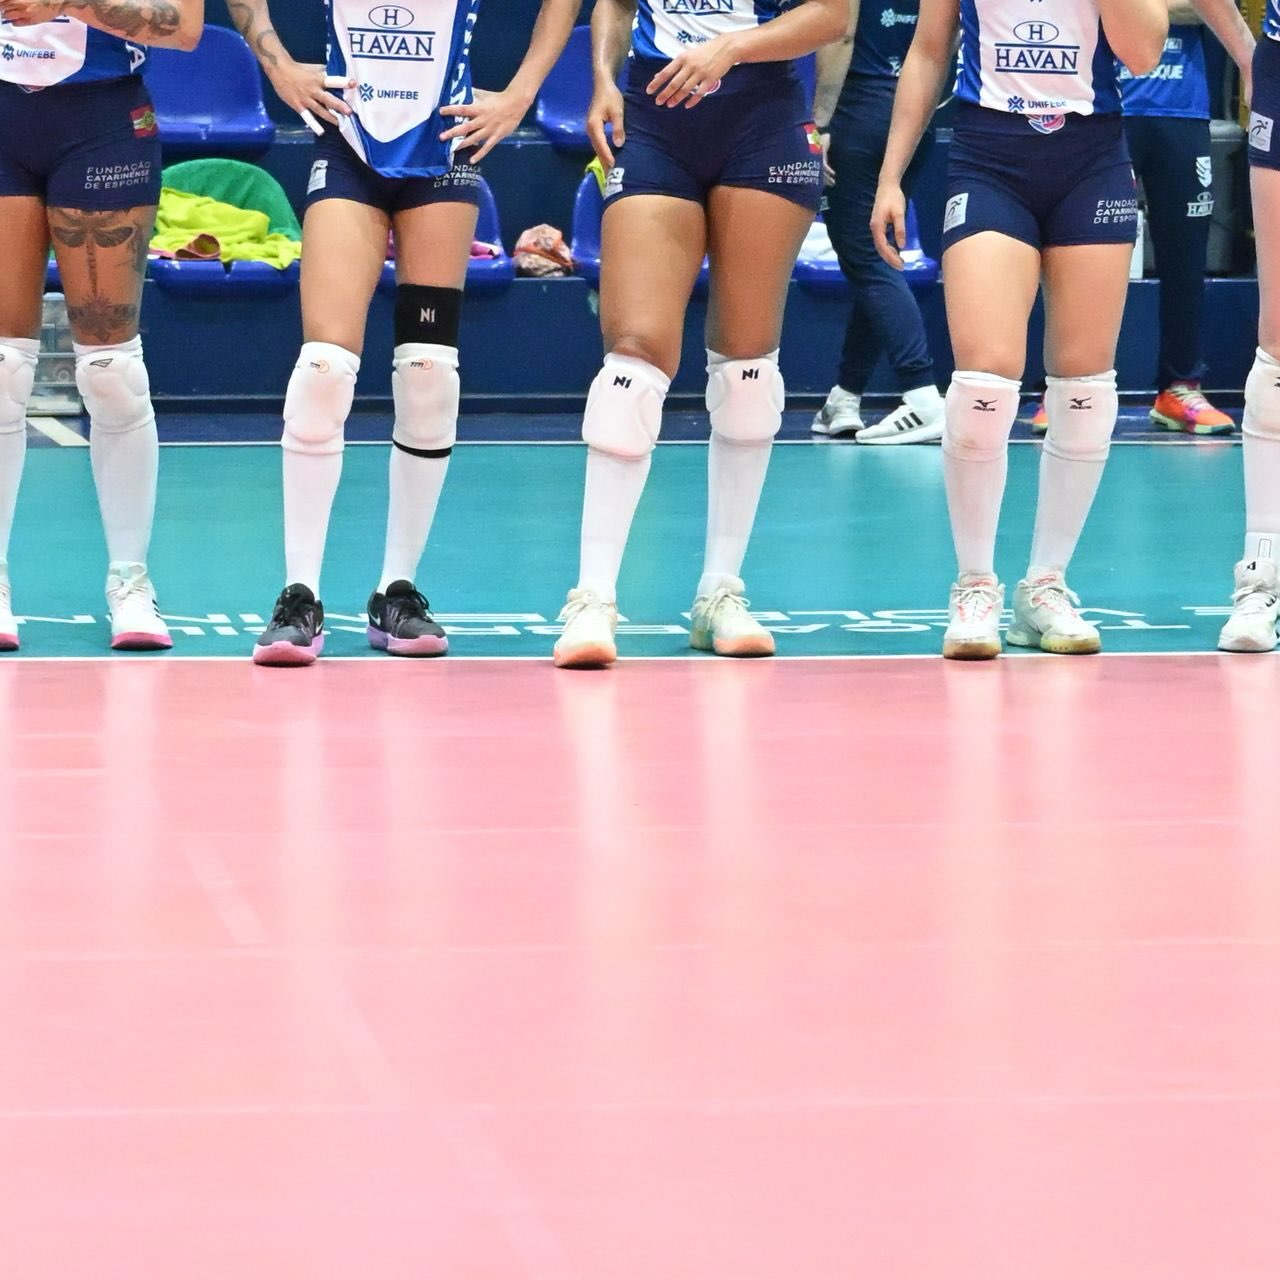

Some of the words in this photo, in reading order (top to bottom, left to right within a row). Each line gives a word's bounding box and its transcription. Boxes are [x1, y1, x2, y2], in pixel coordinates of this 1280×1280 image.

[384, 8, 399, 26] H
[1028, 24, 1045, 41] H
[349, 32, 436, 56] HAVAN
[16, 49, 56, 60] UNIFEBE
[995, 48, 1079, 70] HAVAN
[377, 89, 419, 100] UNIFEBE
[86, 160, 152, 174] FUNDAÇÃO
[768, 161, 821, 172] FUNDAÇÃO
[86, 168, 150, 181] CATARINENSE
[84, 181, 101, 189] DE
[104, 177, 150, 189] ESPORTE
[433, 179, 449, 188] DE
[1097, 199, 1138, 208] FUNDAÇ
[1094, 216, 1109, 224] DE
[1113, 215, 1138, 223] ESPOR
[420, 307, 435, 323] N1
[741, 367, 760, 381] N1
[613, 374, 632, 390] N1
